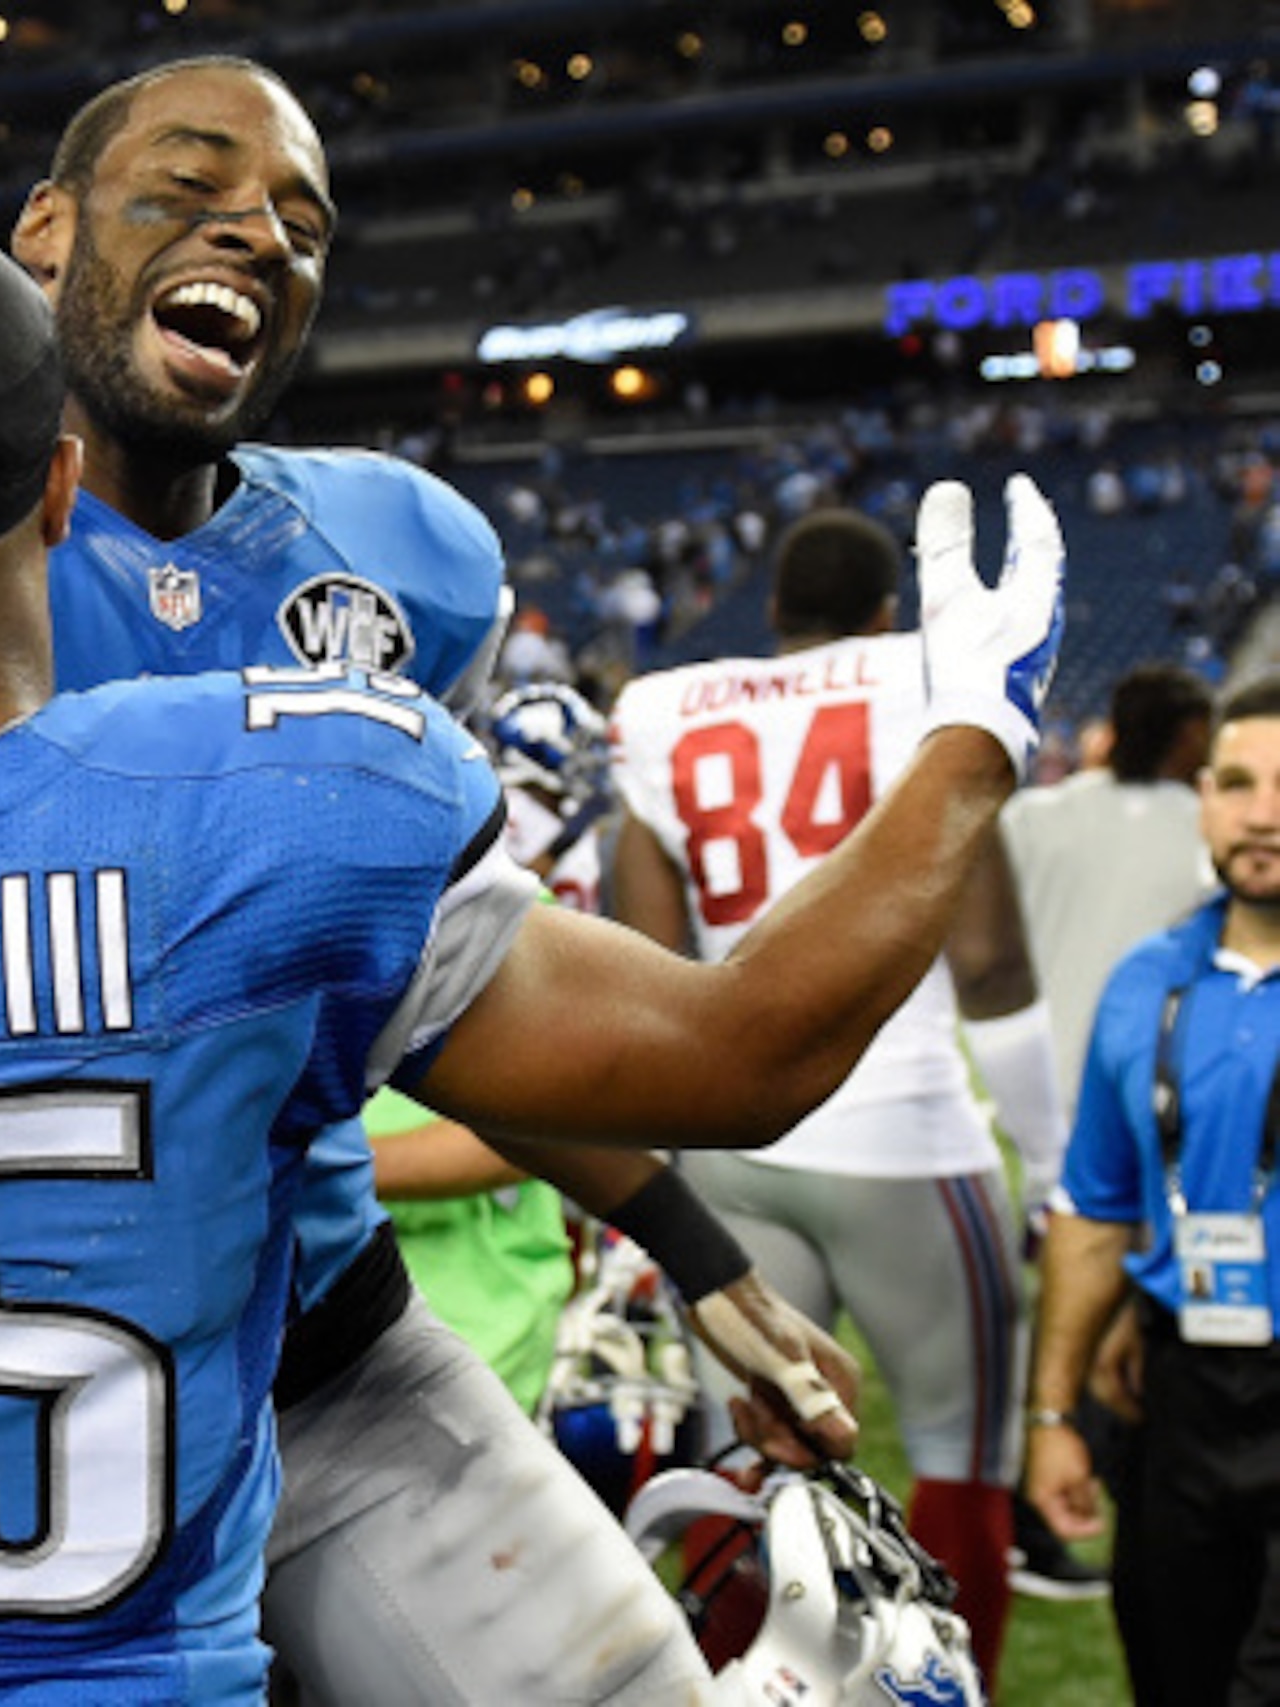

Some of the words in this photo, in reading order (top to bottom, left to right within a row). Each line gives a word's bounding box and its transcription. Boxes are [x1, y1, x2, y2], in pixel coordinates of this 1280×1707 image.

[885, 268, 1105, 337] FORD
[677, 650, 887, 719] DONNELL
[670, 697, 874, 927] 84
[0, 867, 134, 1039] III
